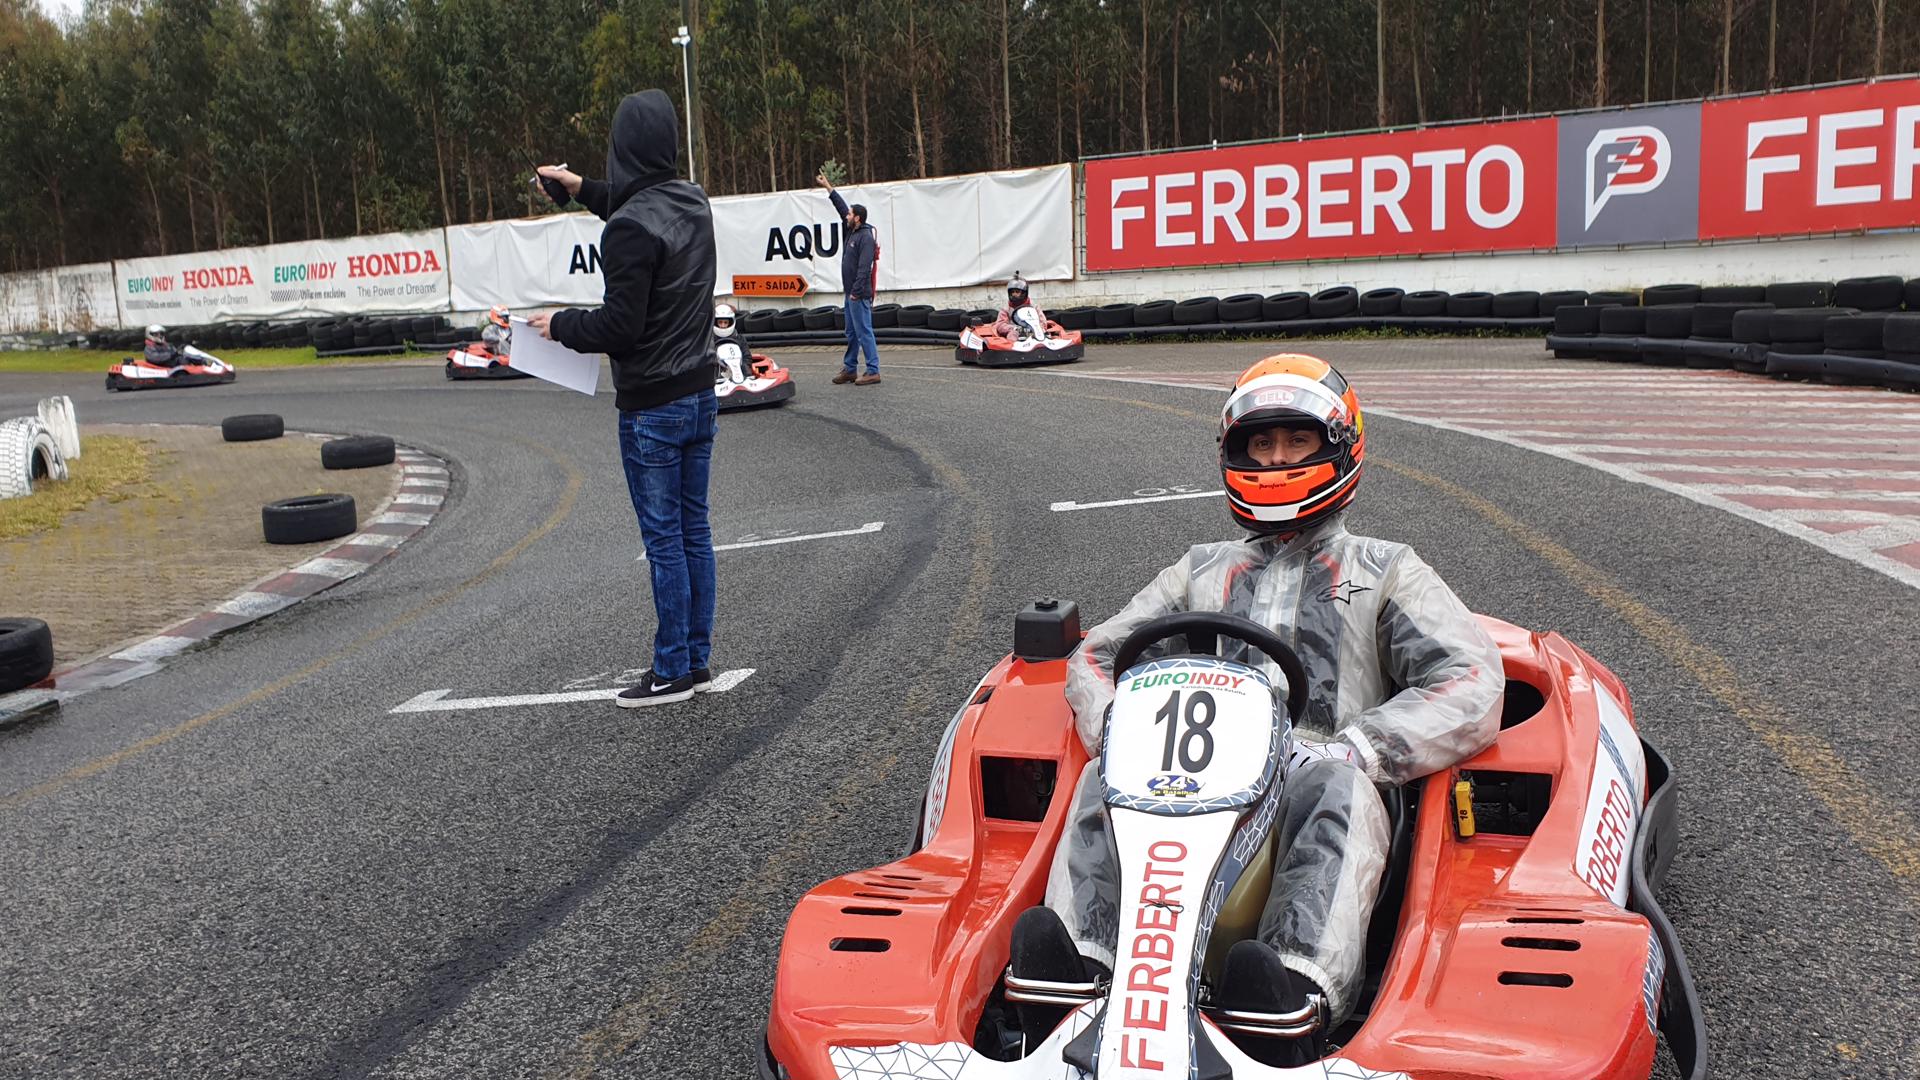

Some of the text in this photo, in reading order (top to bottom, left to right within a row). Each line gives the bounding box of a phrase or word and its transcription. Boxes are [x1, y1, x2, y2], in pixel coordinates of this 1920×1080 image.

[1111, 144, 1524, 250] FERBERTO
[274, 262, 337, 283] EUROINDY
[347, 249, 441, 279] HONDA
[128, 275, 174, 293] EUROINDY
[182, 265, 254, 289] HONDA
[734, 281, 756, 290] EXIT
[765, 279, 796, 290] SAÍDA
[357, 283, 437, 297] The Power of Dreams
[203, 296, 219, 307] Power
[227, 294, 248, 305] Dreams
[1259, 391, 1290, 402] BELL
[1130, 672, 1246, 692] EUROINDY
[1154, 690, 1217, 774] 18
[1153, 775, 1188, 789] 24
[1460, 809, 1469, 821] 18
[1586, 779, 1631, 900] RBERTO
[1120, 840, 1188, 1072] FERBERTO
